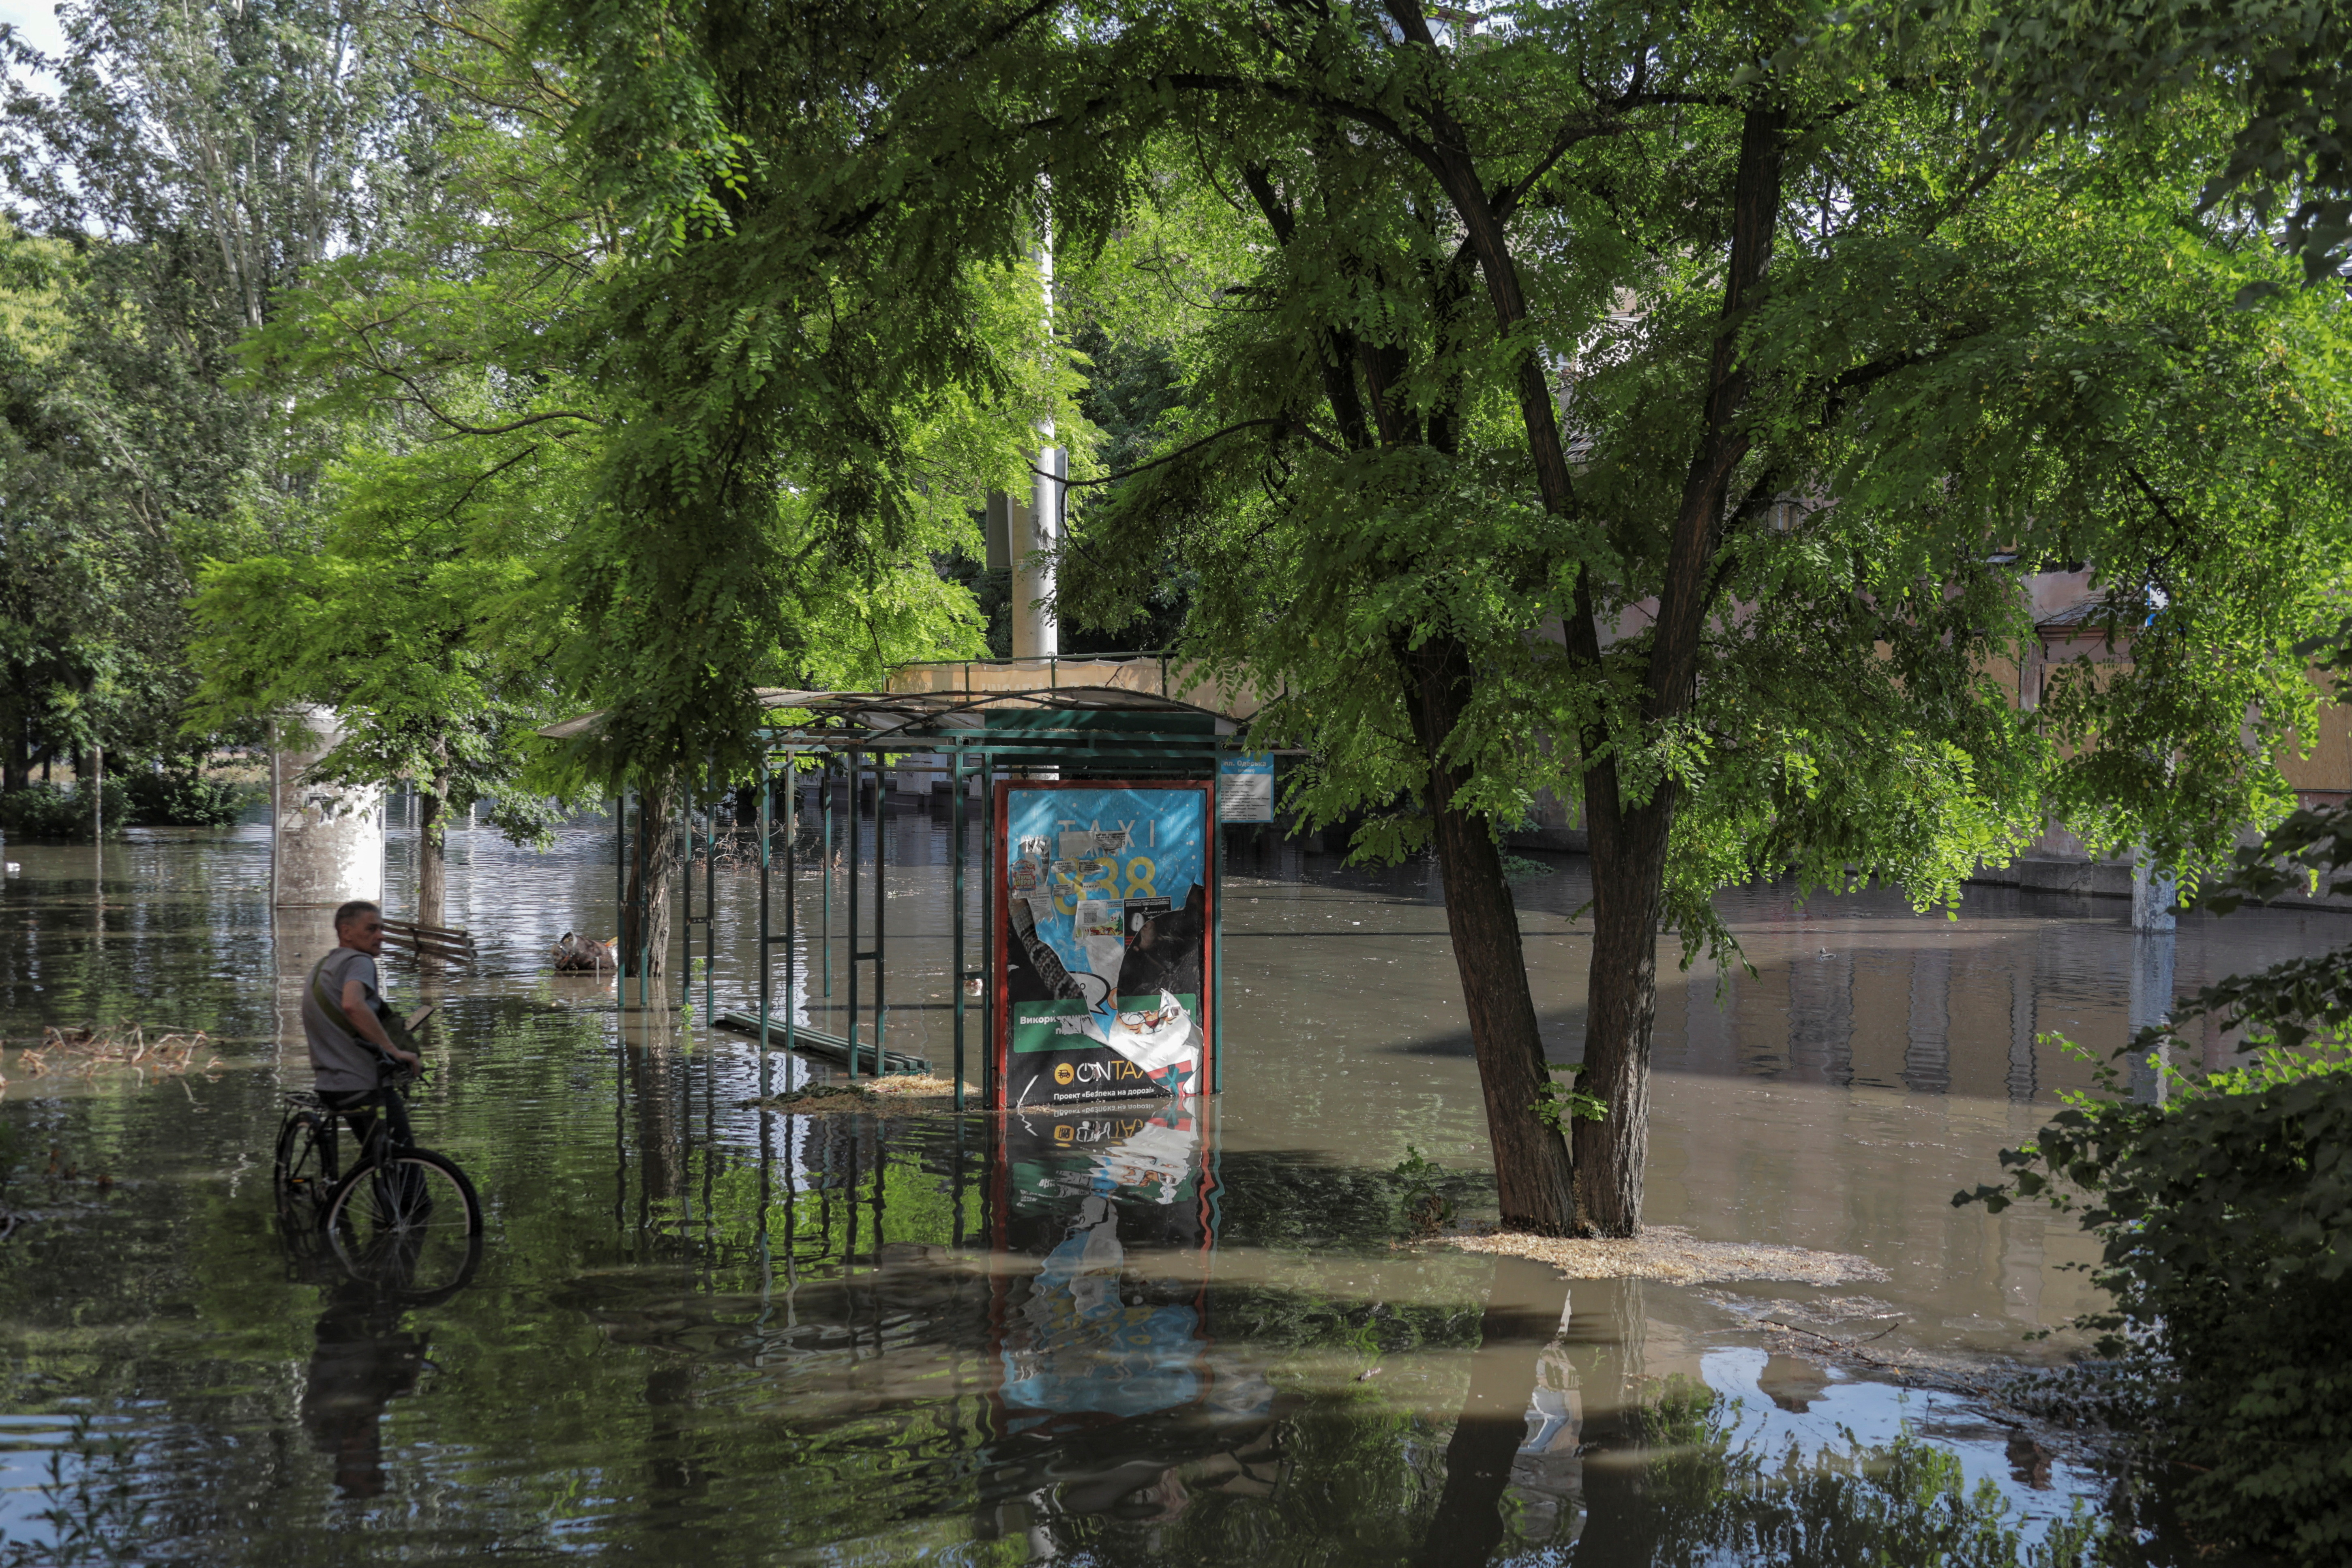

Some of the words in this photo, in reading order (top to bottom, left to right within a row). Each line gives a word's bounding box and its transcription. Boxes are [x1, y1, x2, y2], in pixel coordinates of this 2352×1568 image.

[1054, 856, 1157, 916] 838
[1054, 1093, 1081, 1101] Проект
[1127, 1087, 1155, 1096] дорозі»
